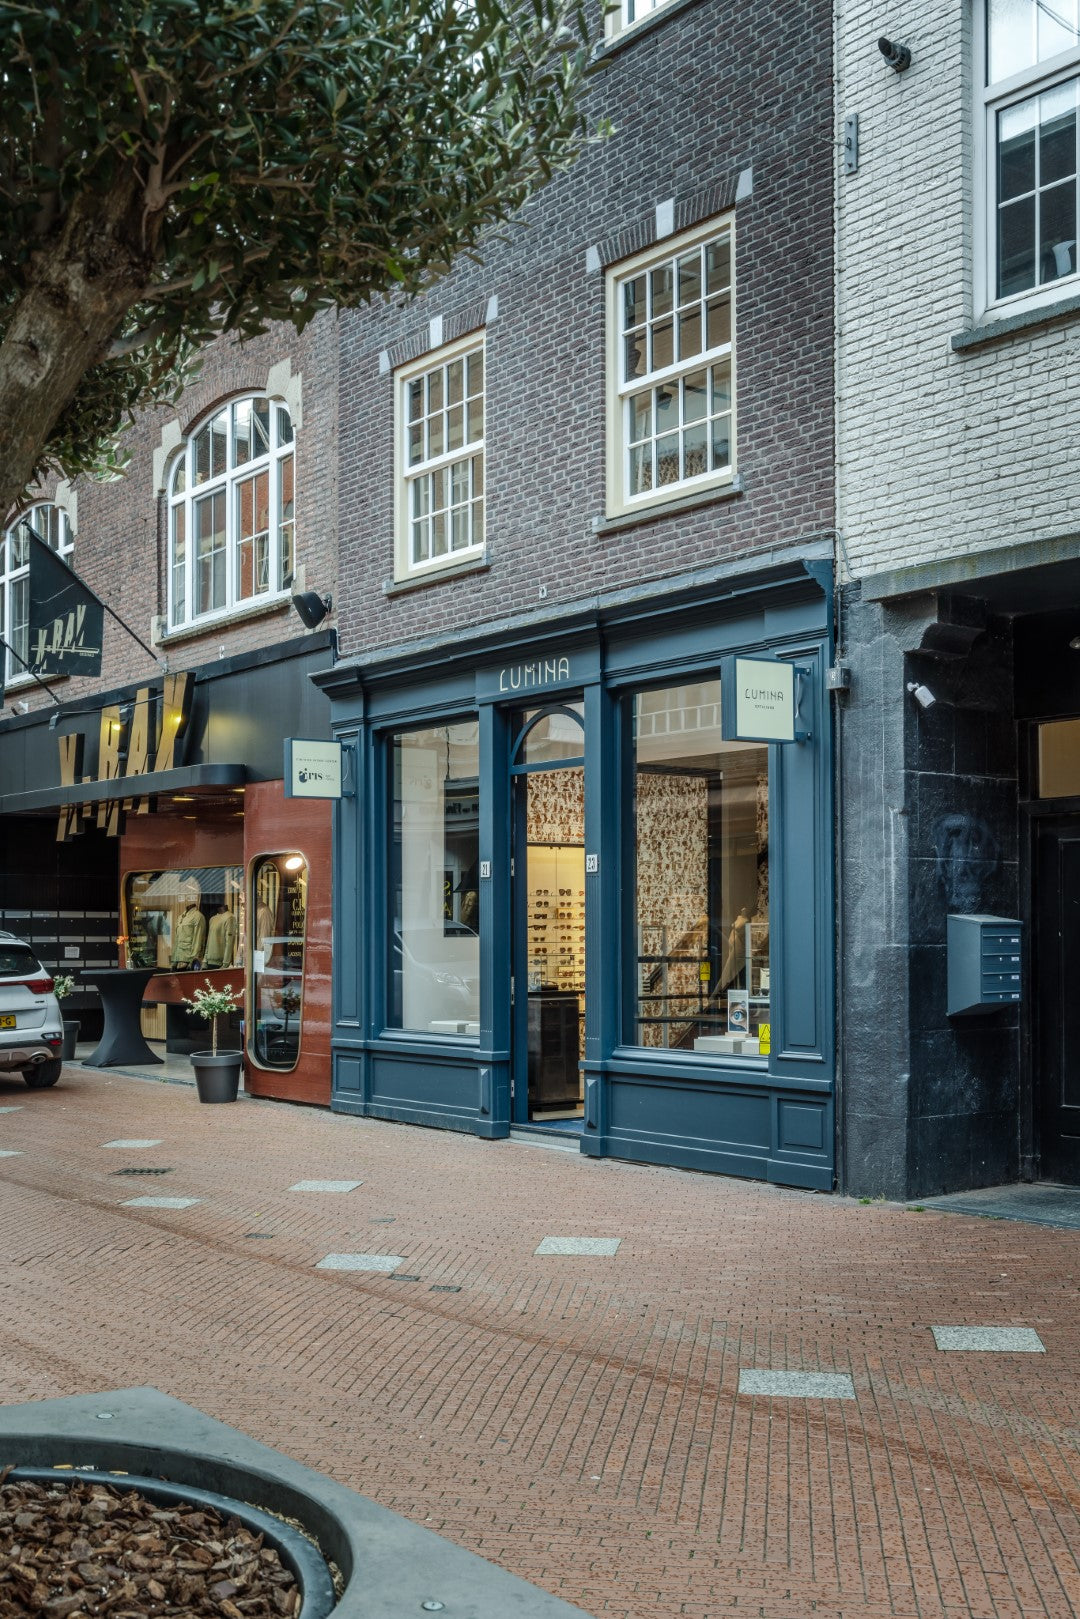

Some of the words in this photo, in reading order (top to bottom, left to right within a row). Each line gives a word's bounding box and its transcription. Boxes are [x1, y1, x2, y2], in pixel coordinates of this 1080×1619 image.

[499, 657, 570, 692] LUMINA
[745, 688, 784, 702] LUMINA
[482, 863, 488, 876] 21
[588, 857, 596, 871] 23
